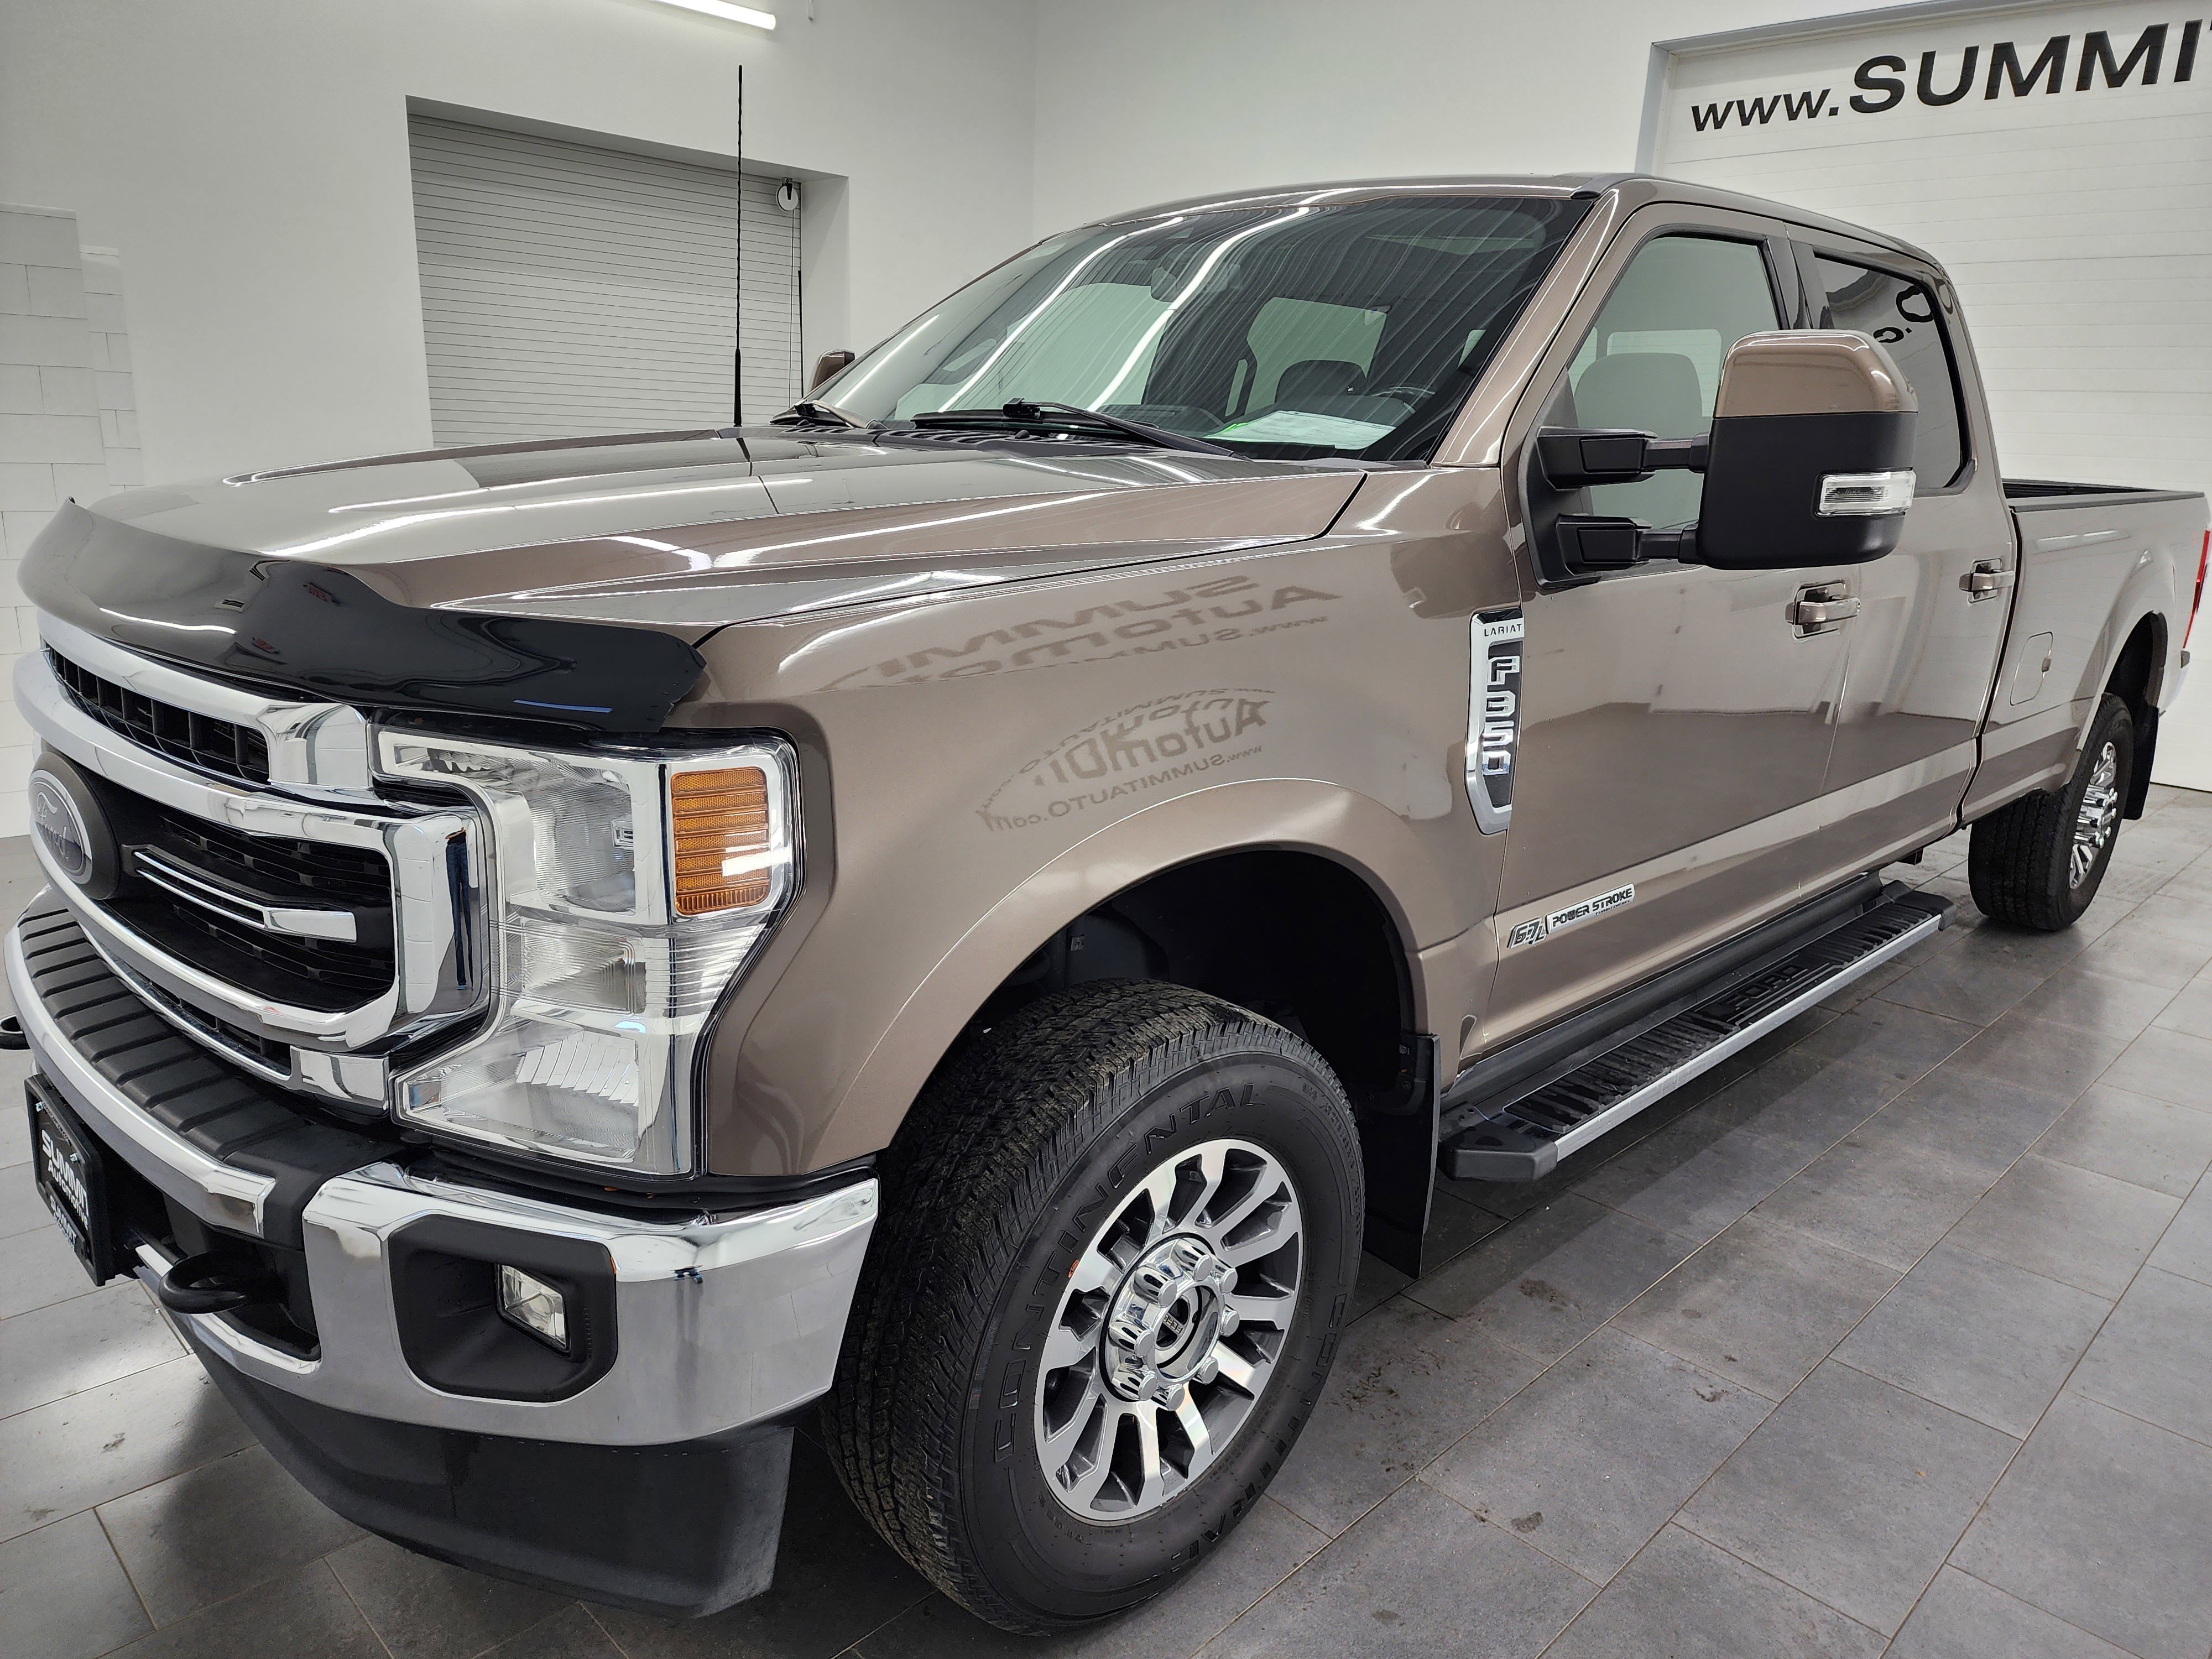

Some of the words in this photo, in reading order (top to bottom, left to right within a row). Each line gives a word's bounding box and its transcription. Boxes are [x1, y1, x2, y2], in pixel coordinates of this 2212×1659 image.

[1691, 18, 2212, 133] www.SUMMI
[1484, 623, 1522, 637] LARIAT
[35, 791, 69, 860] Ford
[1512, 919, 1547, 945] 6.7L
[1552, 905, 1590, 927] POWER
[1592, 888, 1633, 912] STROKE
[41, 1129, 89, 1218] SUMMIT
[48, 1159, 88, 1231] Automotive
[994, 1083, 1265, 1462] CONTINENTAL
